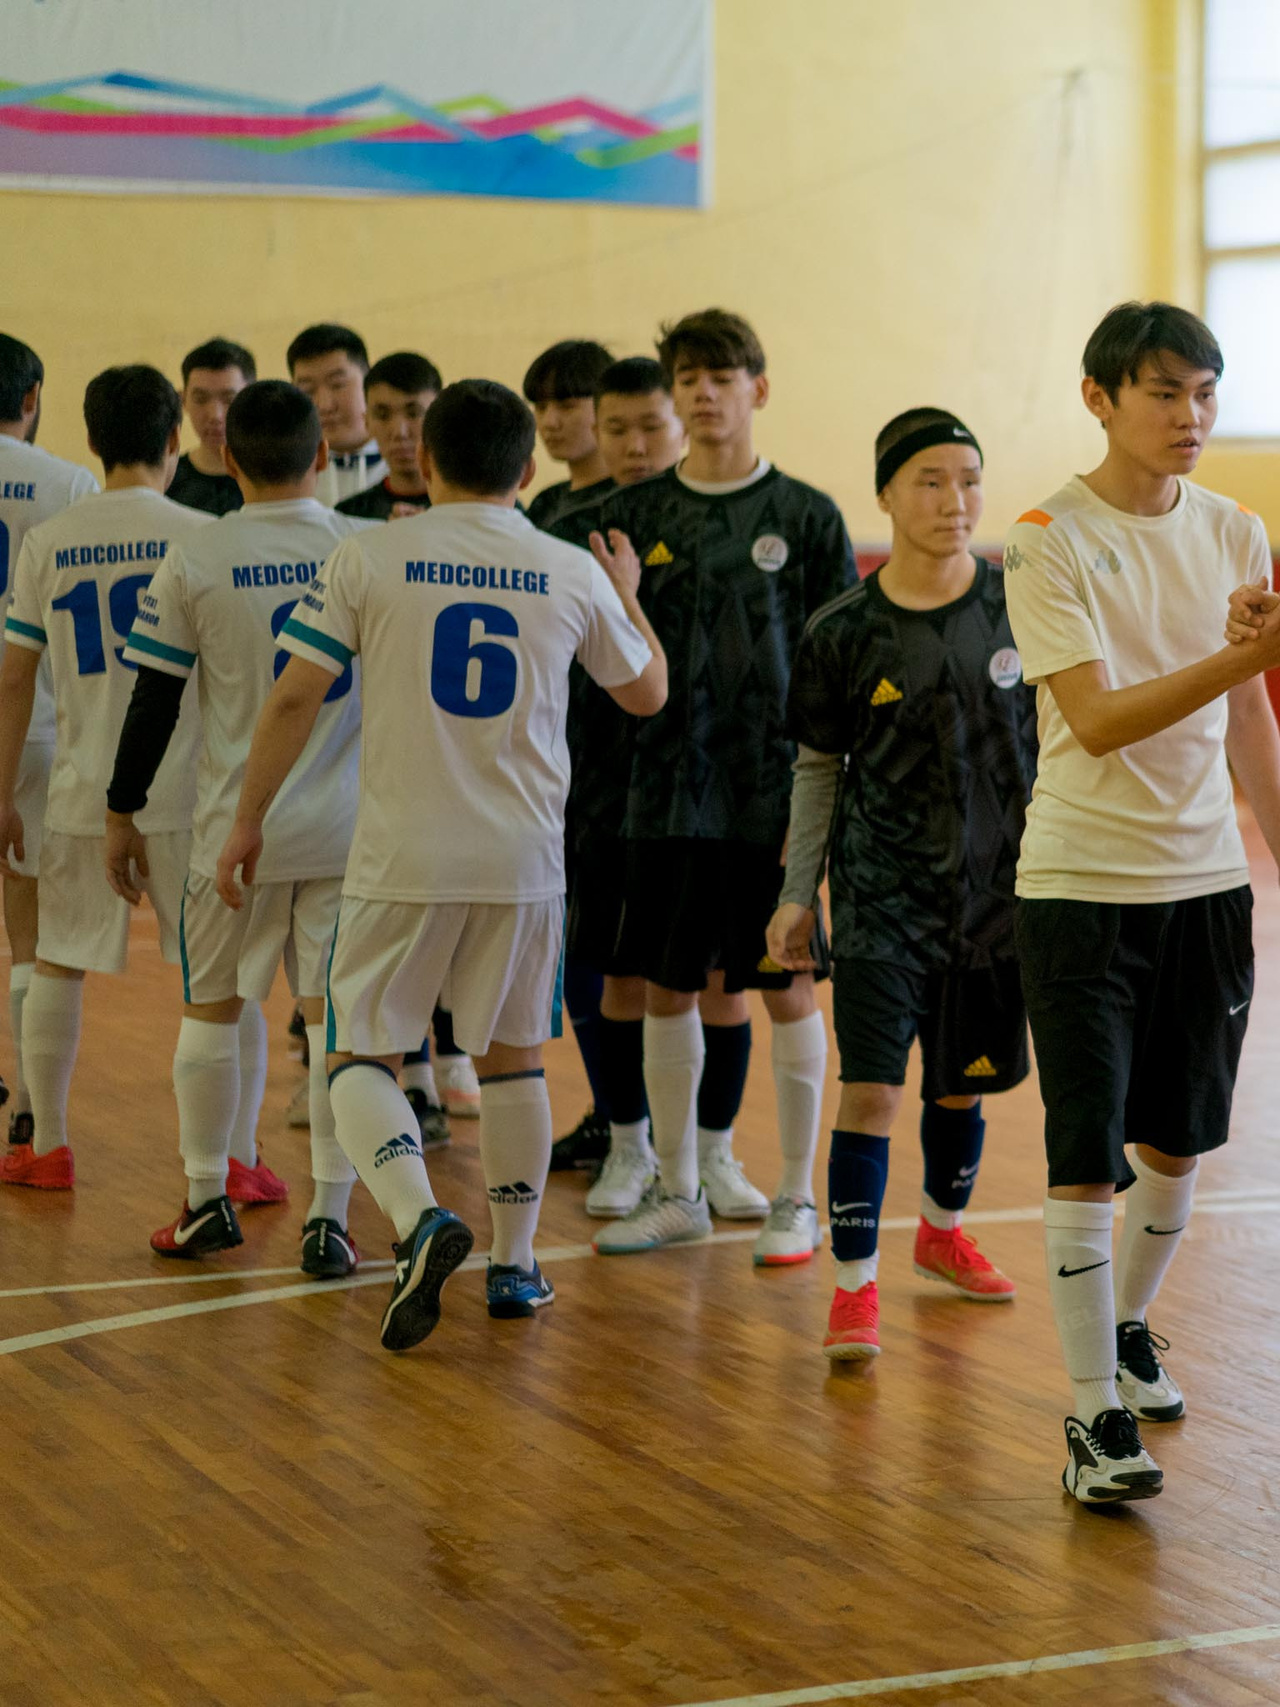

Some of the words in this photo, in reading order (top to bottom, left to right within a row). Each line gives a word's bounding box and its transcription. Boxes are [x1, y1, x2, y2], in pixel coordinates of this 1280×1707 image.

[405, 560, 550, 596] MEDCOLLEGE
[430, 601, 520, 719] 6
[830, 1216, 876, 1228] PARIS
